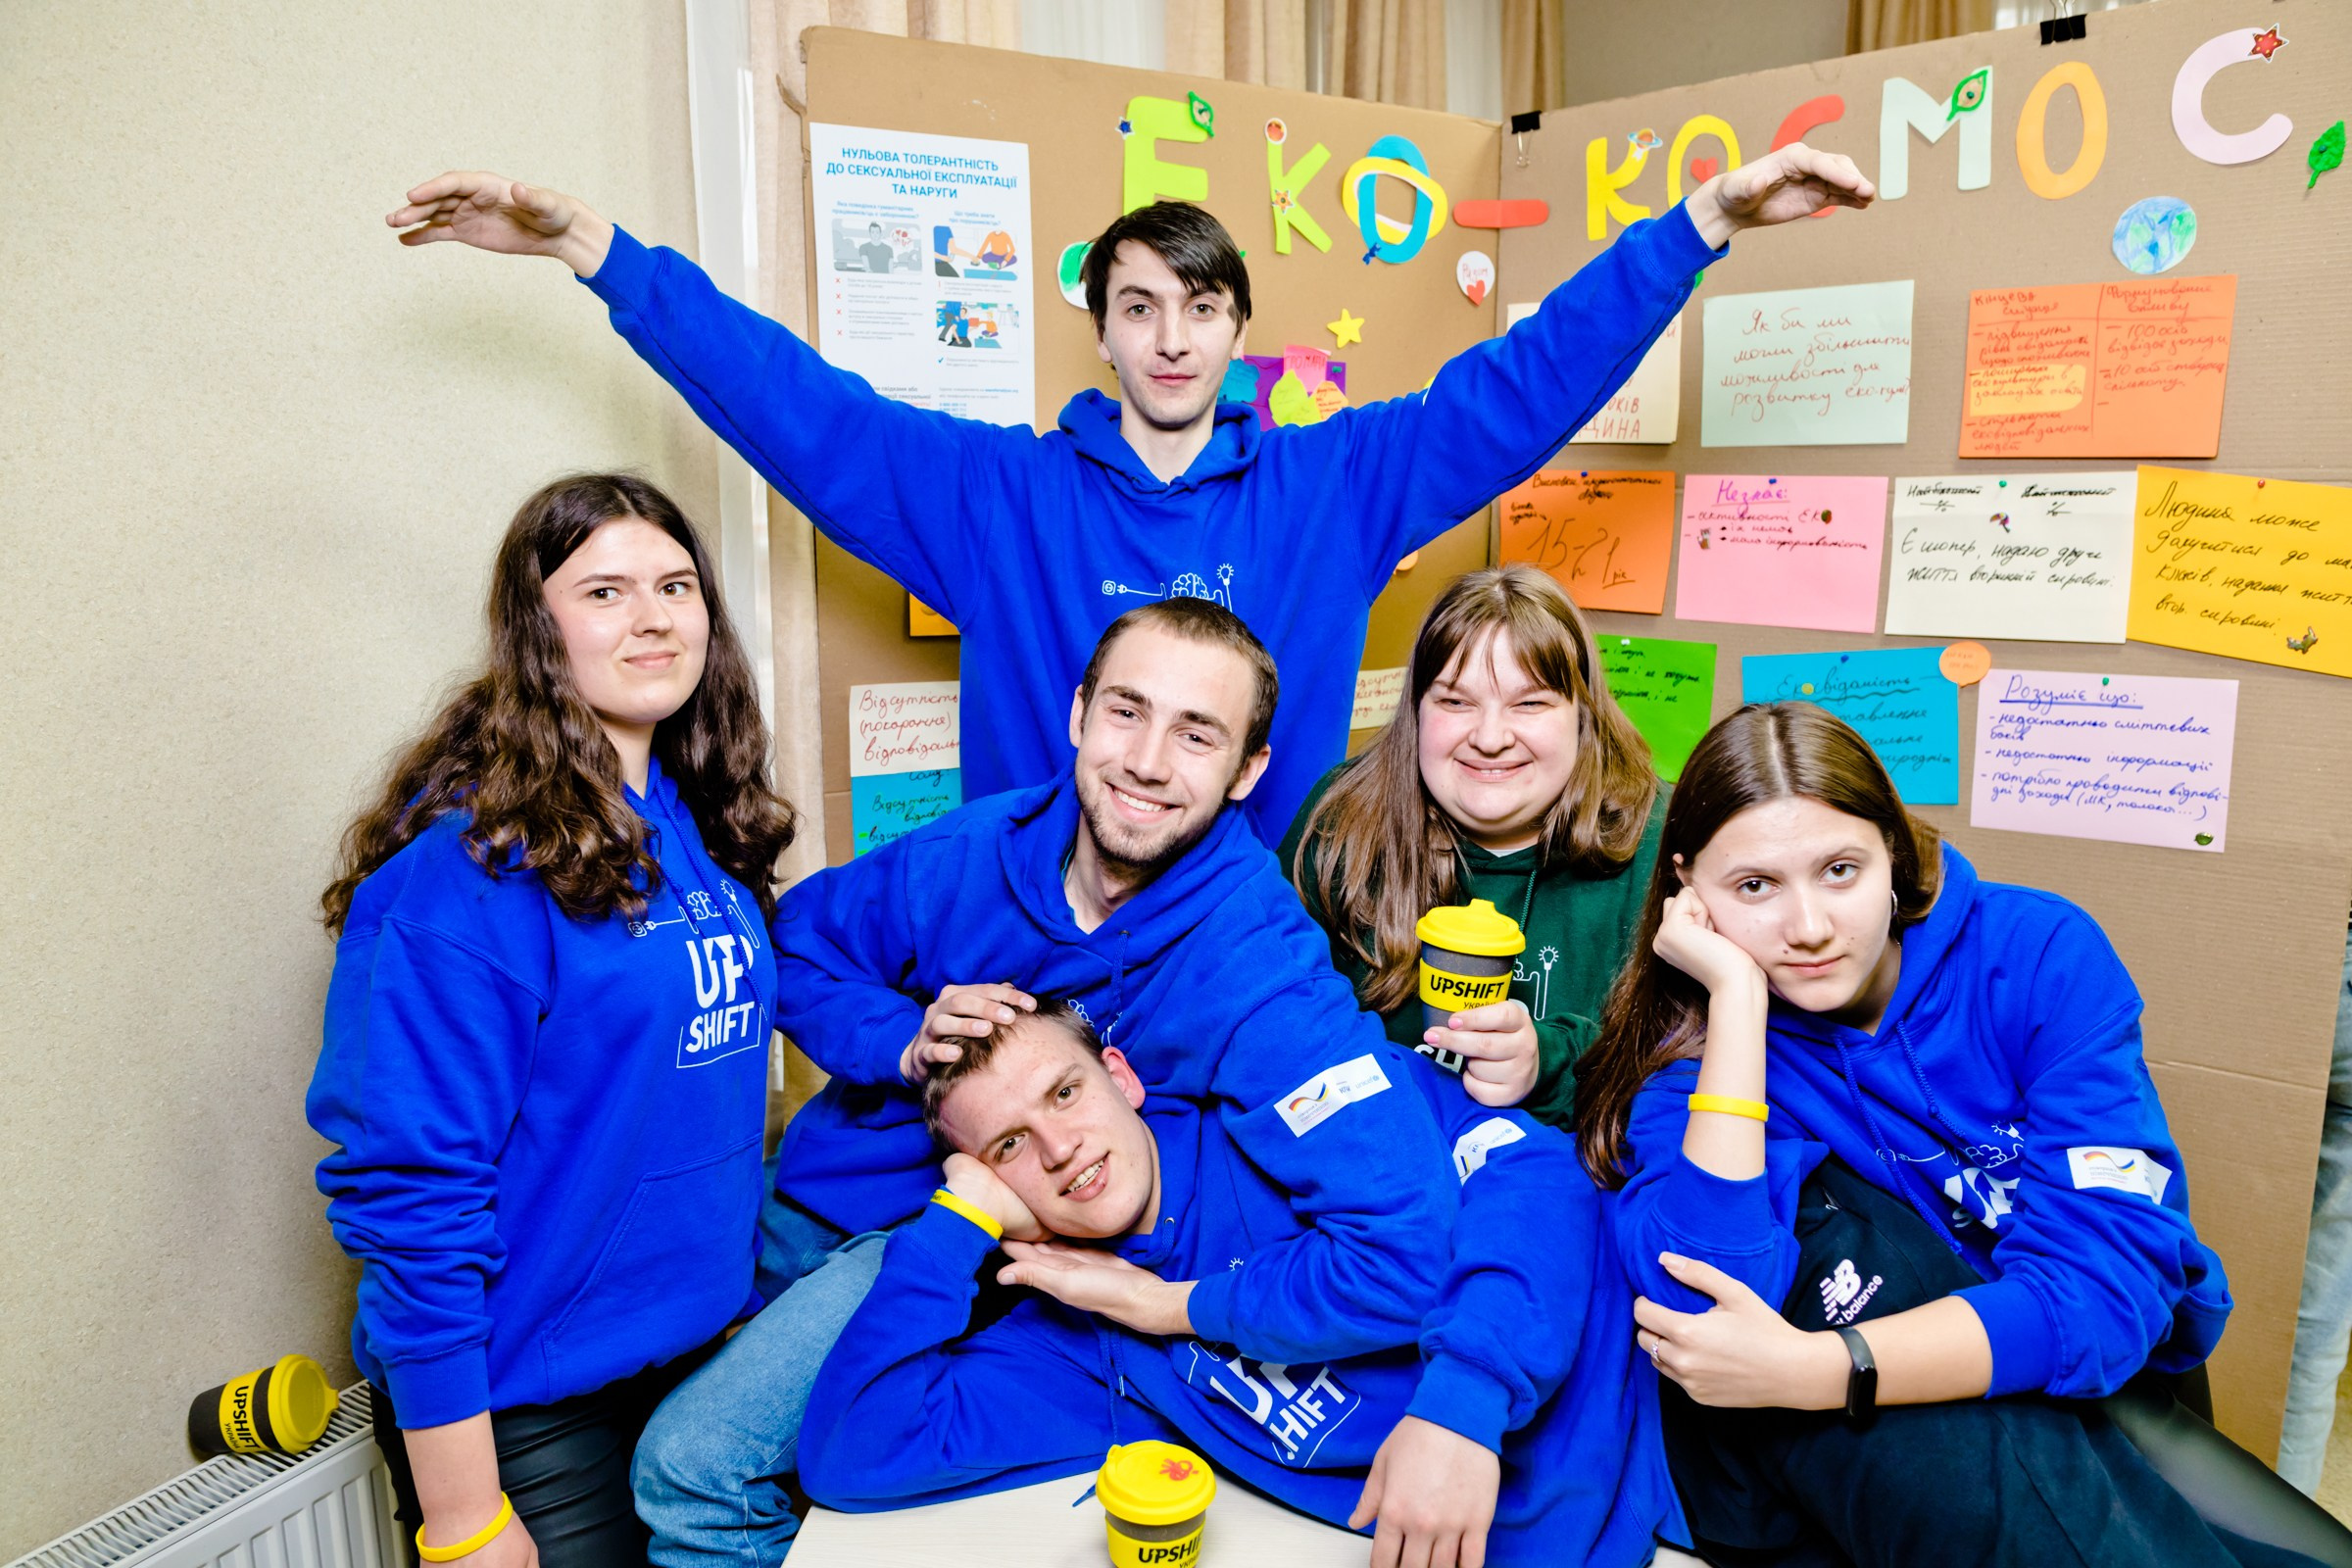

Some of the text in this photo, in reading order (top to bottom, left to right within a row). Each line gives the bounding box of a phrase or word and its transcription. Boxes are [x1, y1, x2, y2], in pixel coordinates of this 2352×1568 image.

[842, 147, 999, 172] НУЛЬОВА ТОЛЕРАНТНІСТЬ
[826, 163, 1017, 189] ДО СЕКСУАЛЬНОЇ ЕКСПЛУАТАЦІЇ
[892, 183, 957, 199] ТА НАРУГИ
[2128, 324, 2157, 340] 100
[1431, 974, 1505, 999] UPSHIFT
[685, 1001, 756, 1054] SHIFT
[1840, 1274, 1884, 1323] balance
[232, 1385, 261, 1449] UPSHIFT
[1268, 1366, 1347, 1460] HIFT
[1138, 1534, 1201, 1564] UPSHIF
